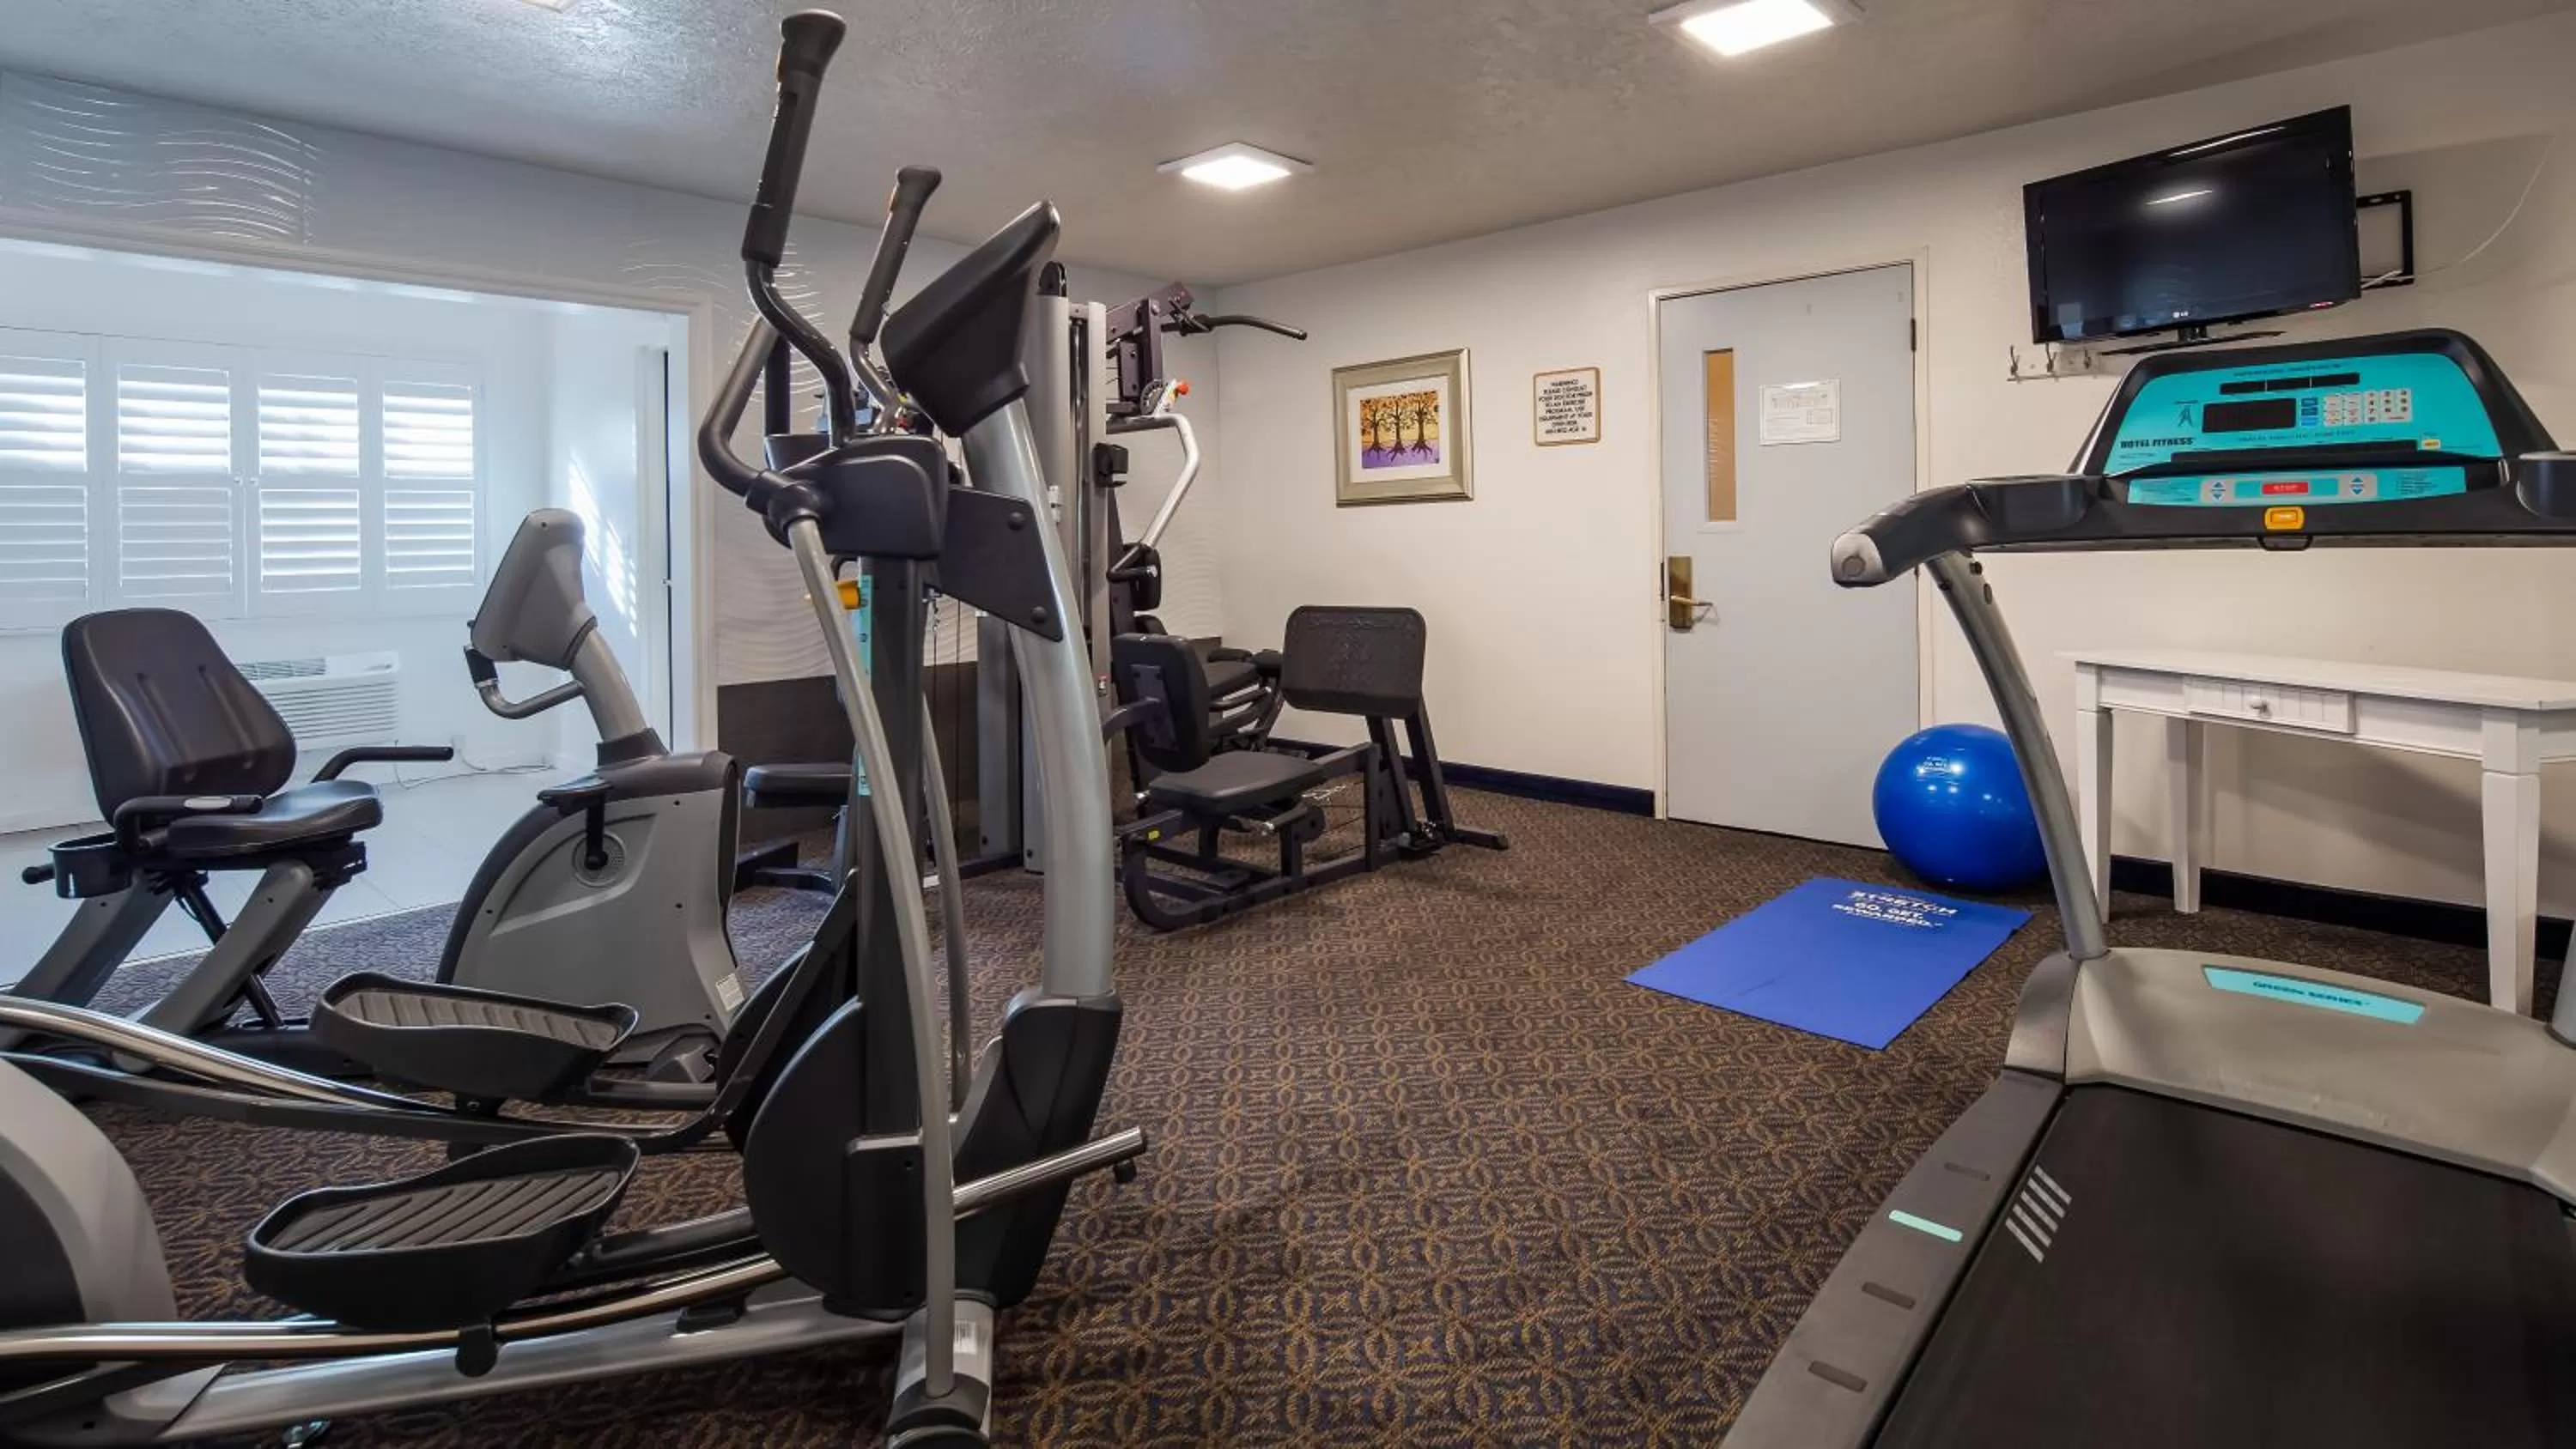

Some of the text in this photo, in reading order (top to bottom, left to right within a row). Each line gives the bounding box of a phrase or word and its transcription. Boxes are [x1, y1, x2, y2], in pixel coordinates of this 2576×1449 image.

[2120, 436, 2195, 449] HOTEL FITNESS
[2252, 981, 2305, 996] GREEN
